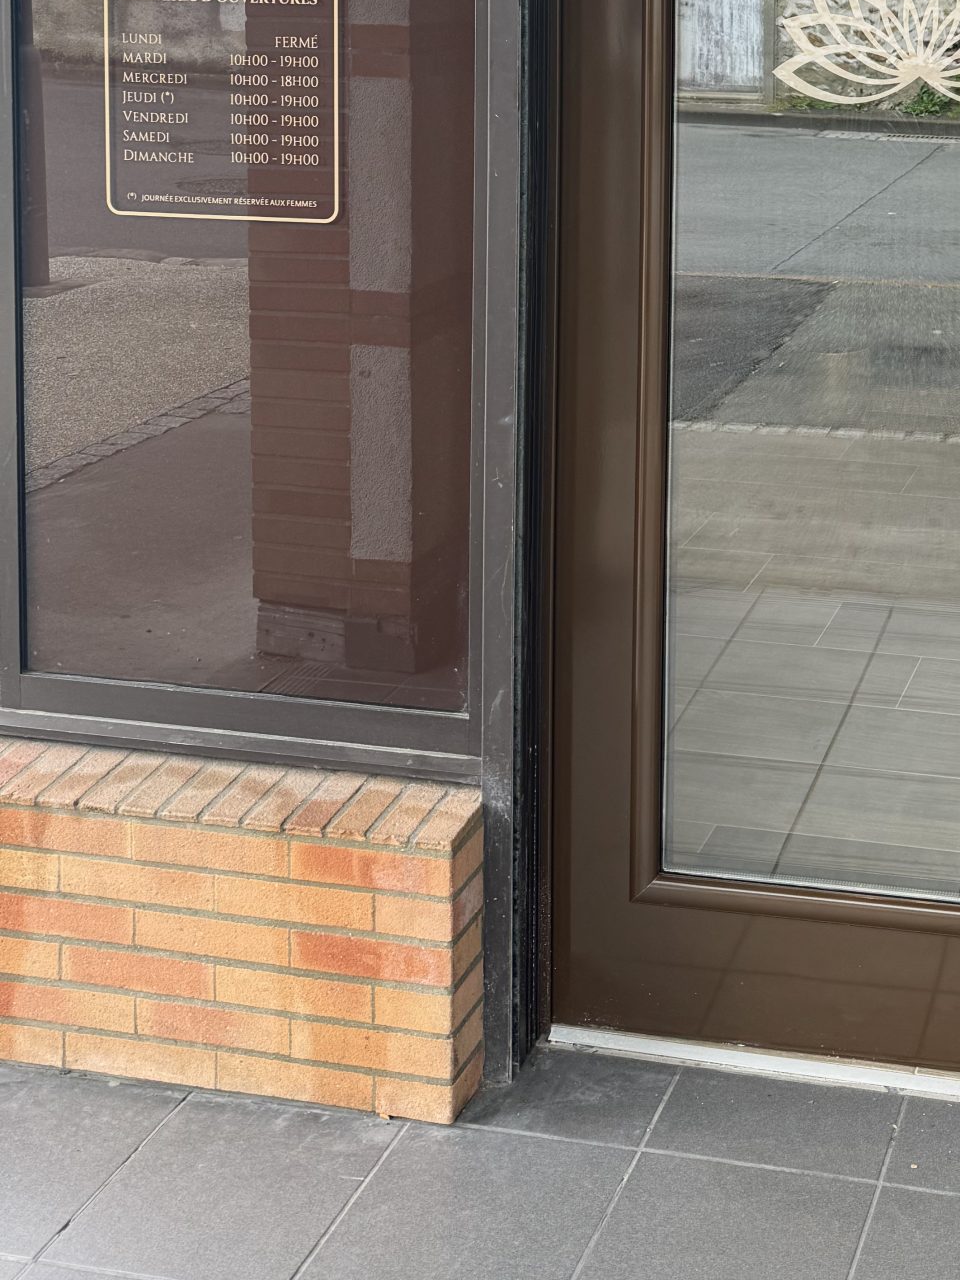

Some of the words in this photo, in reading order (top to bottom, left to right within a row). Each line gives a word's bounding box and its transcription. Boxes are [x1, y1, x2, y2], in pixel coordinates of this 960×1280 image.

[121, 32, 162, 45] LUNDI
[275, 34, 319, 49] FERMÉ
[122, 52, 167, 64] MARDI
[230, 54, 269, 67] 10H00
[280, 56, 319, 68] 19H00
[122, 72, 188, 85] MERCREDI
[230, 73, 269, 87] 10H00
[280, 75, 319, 88] 18H00
[122, 91, 157, 104] JEUDI
[230, 93, 269, 107] 10H00
[280, 95, 319, 108] 19H00
[122, 111, 189, 124] VENDREDI
[230, 113, 269, 126] 10H00
[280, 114, 319, 128] 19H00
[123, 130, 170, 143] SAMEDI
[230, 132, 269, 146] 10H00
[280, 134, 319, 148] 19H00
[123, 149, 194, 163] DIMANCHE
[230, 151, 269, 164] 10H00
[280, 153, 319, 166] 19H00
[174, 195, 232, 205] EXCLUSIVEMENT
[270, 199, 286, 207] AUX
[286, 199, 318, 208] FEMMES
